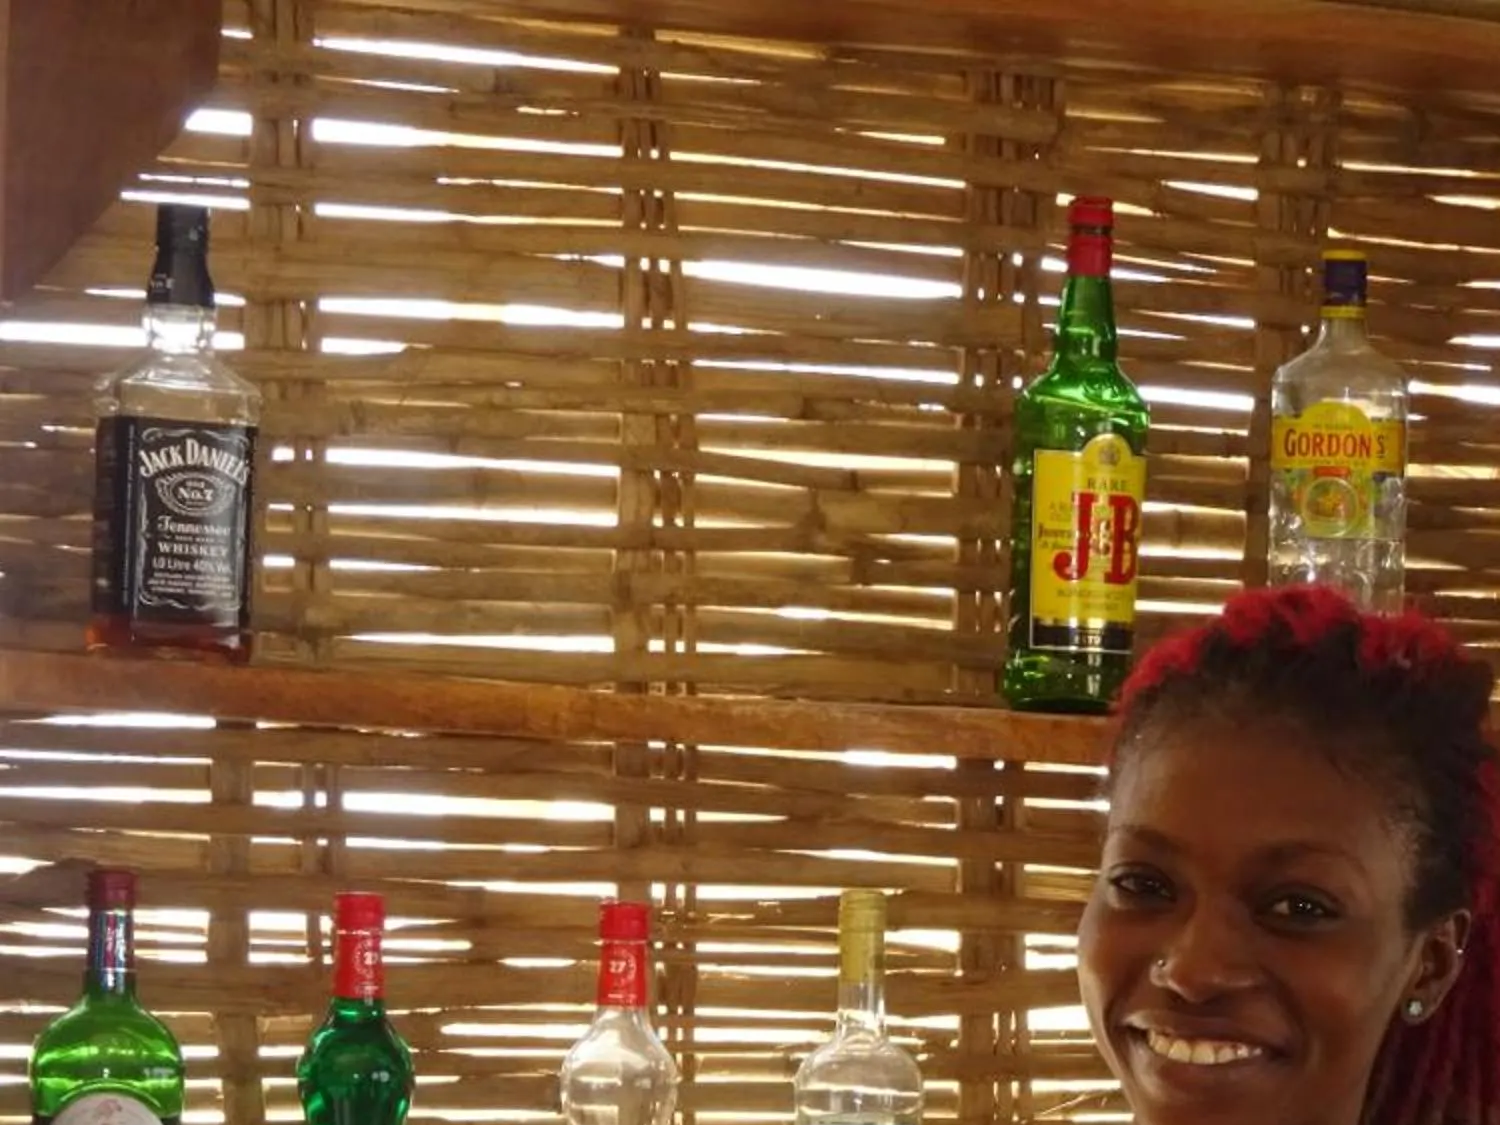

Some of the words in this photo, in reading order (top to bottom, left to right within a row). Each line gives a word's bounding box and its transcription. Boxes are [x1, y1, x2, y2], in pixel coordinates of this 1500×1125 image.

[1284, 428, 1386, 458] GORDONS
[139, 445, 184, 478] JACK
[158, 541, 229, 557] WHISKEY
